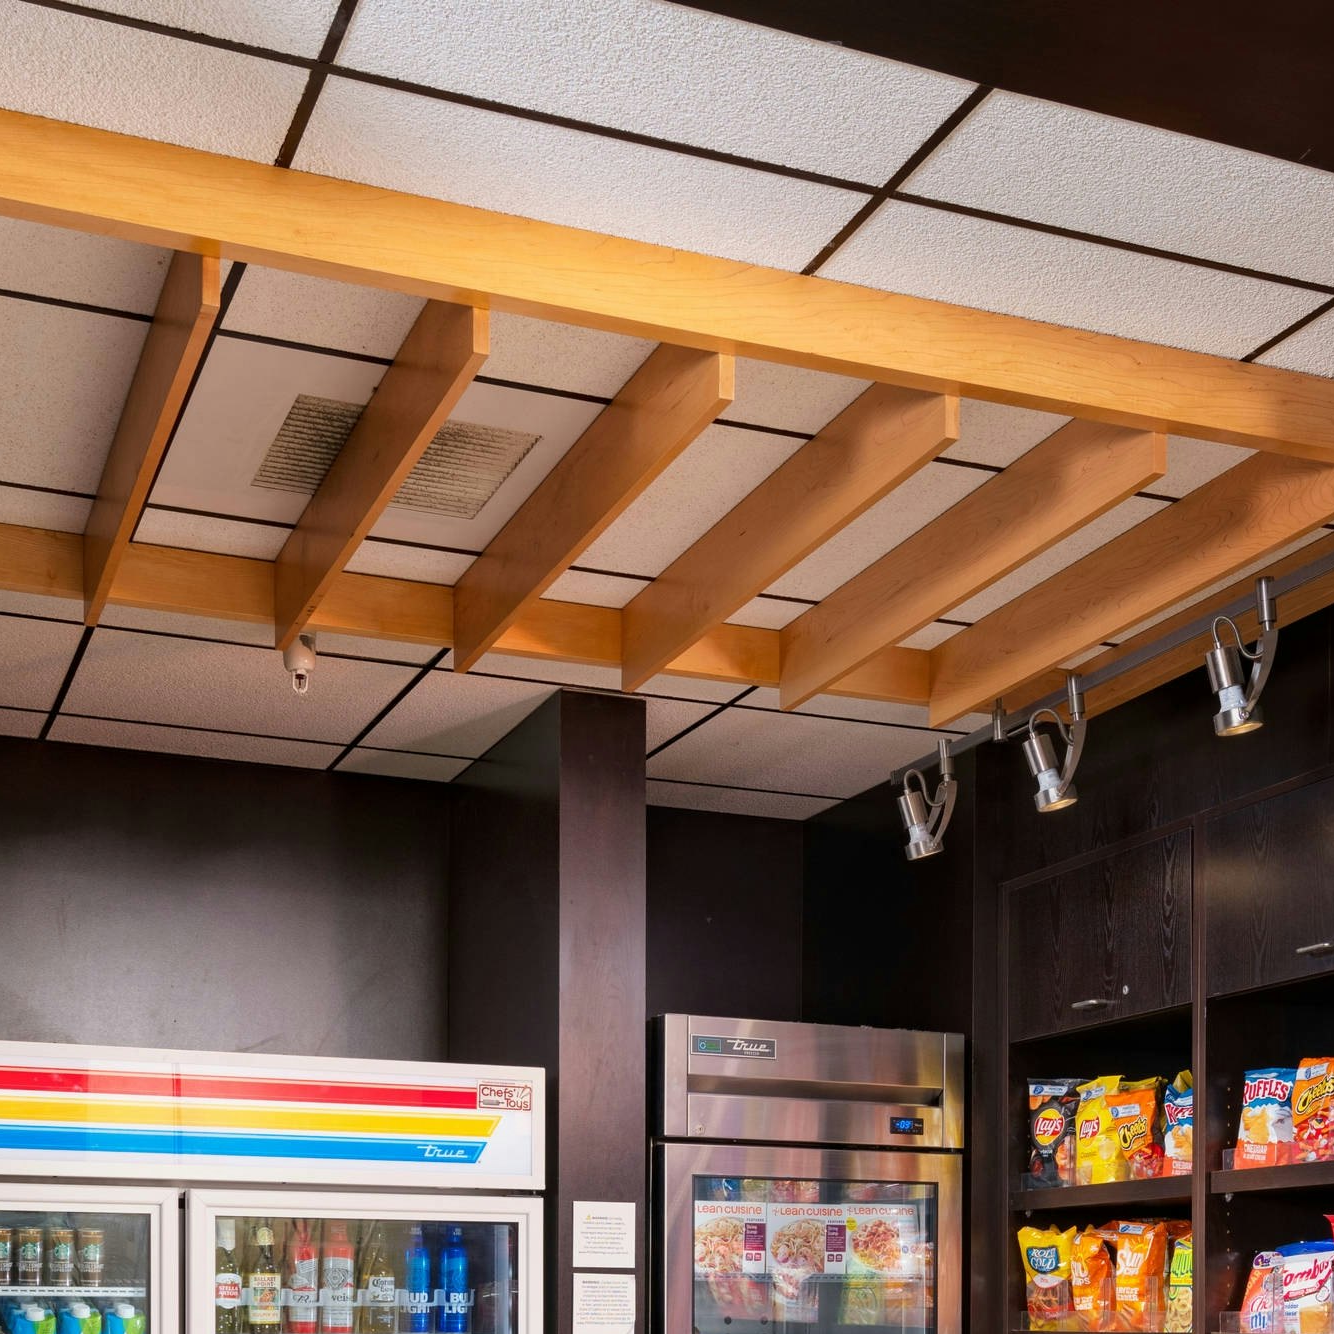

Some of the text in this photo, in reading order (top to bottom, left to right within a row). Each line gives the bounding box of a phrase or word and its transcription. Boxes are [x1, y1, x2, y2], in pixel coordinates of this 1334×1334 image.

[482, 1086, 516, 1100] Chefs'
[1243, 1079, 1290, 1105] RUFFLES
[505, 1098, 529, 1110] Toys
[1036, 1116, 1064, 1136] Lay's
[1080, 1116, 1100, 1138] Lay's
